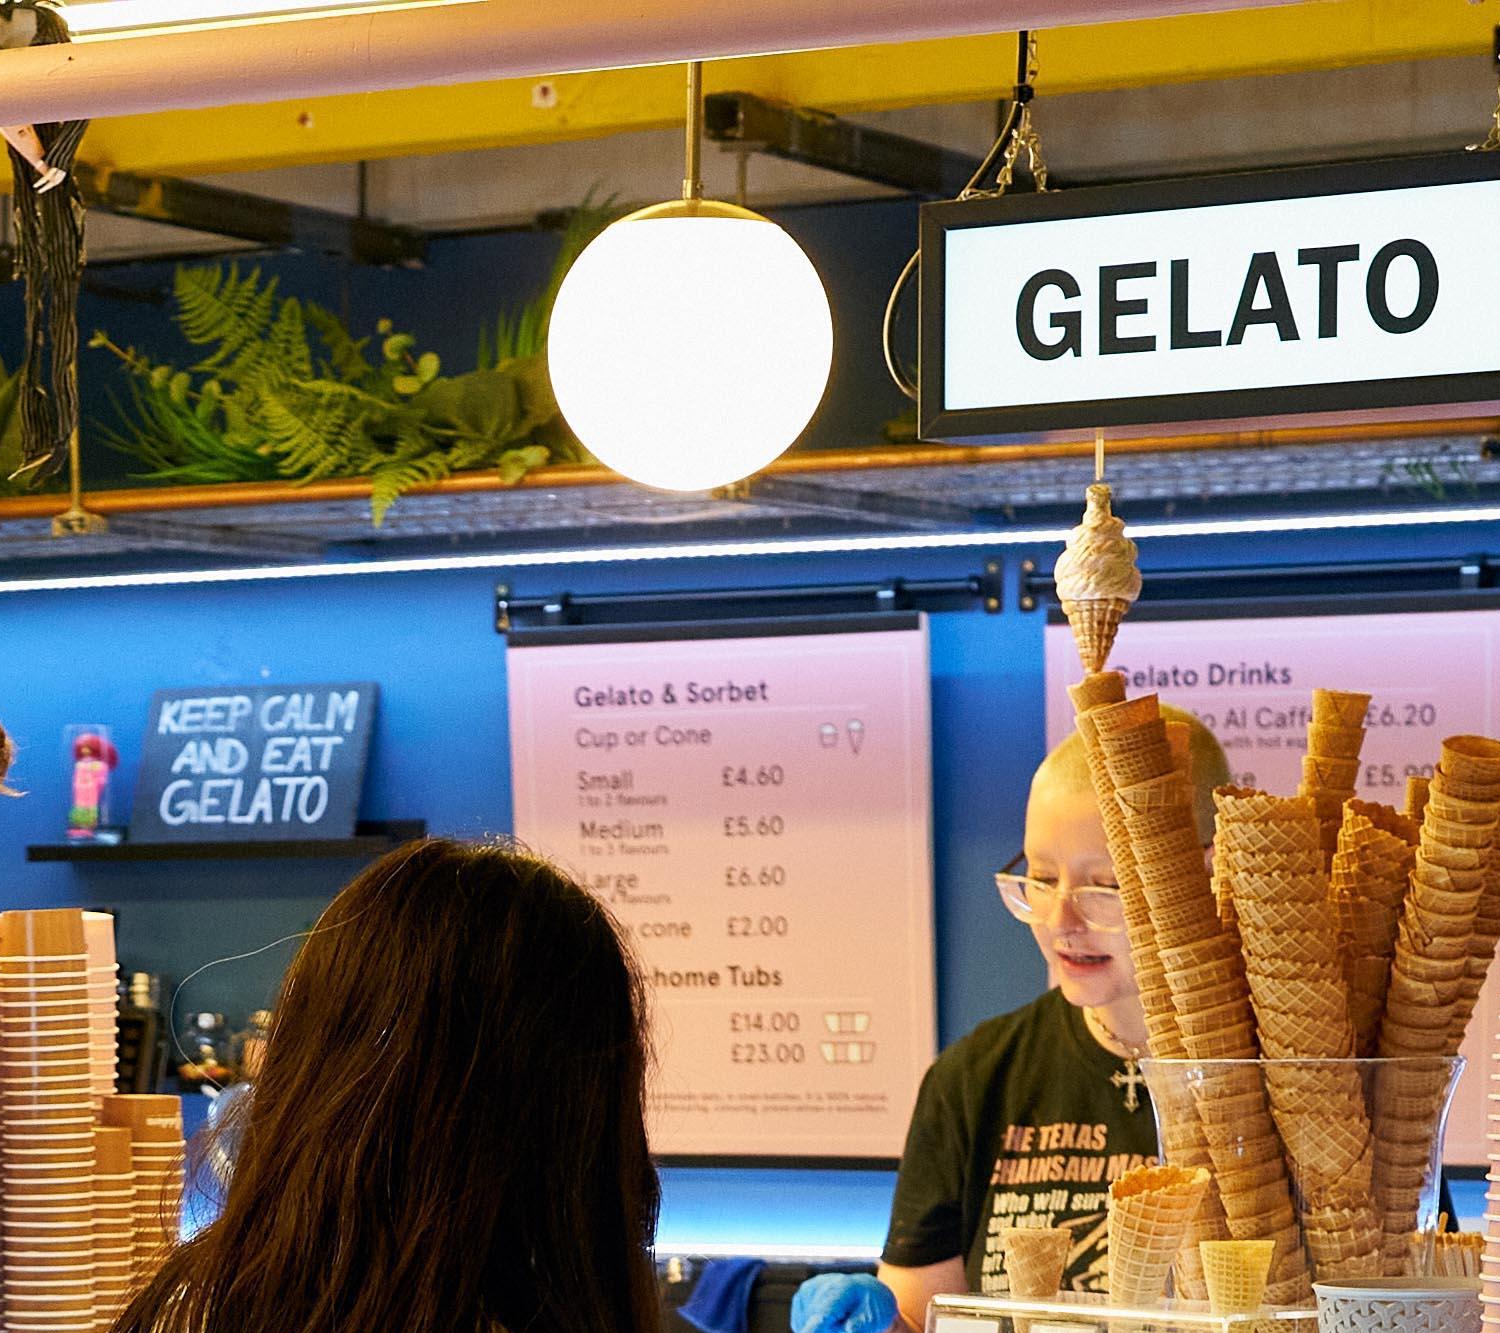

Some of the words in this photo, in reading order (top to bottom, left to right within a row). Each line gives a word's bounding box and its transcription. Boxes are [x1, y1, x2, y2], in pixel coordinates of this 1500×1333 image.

[1015, 238, 1440, 361] GELATO
[1208, 662, 1292, 687] Drinks
[575, 684, 654, 707] Gelato
[661, 683, 677, 705] &
[687, 680, 769, 704] Sorbet
[158, 694, 252, 733] KEEP
[261, 690, 360, 732] CALM
[1223, 708, 1247, 729] Al
[1255, 707, 1312, 729] Caff
[1365, 704, 1437, 728] £6.20
[575, 728, 619, 751] Cup
[625, 730, 648, 746] or
[655, 725, 712, 746] Cone
[171, 737, 249, 774] AND
[261, 735, 344, 772] EAT
[578, 770, 634, 791] Small
[722, 765, 785, 787] £4.60
[159, 775, 329, 825] GELATO
[579, 820, 664, 839] Medium
[723, 815, 785, 837] £5.60
[725, 866, 786, 887] £6.60
[640, 920, 692, 938] cone
[726, 915, 789, 938] £2.00
[643, 966, 721, 988] -home
[727, 965, 783, 988] Tubs
[730, 1012, 800, 1034] £14.00
[731, 1043, 806, 1065] £23.00
[1039, 1122, 1108, 1151] TEXAS
[993, 1191, 1030, 1215] Who
[1033, 1189, 1068, 1211] will
